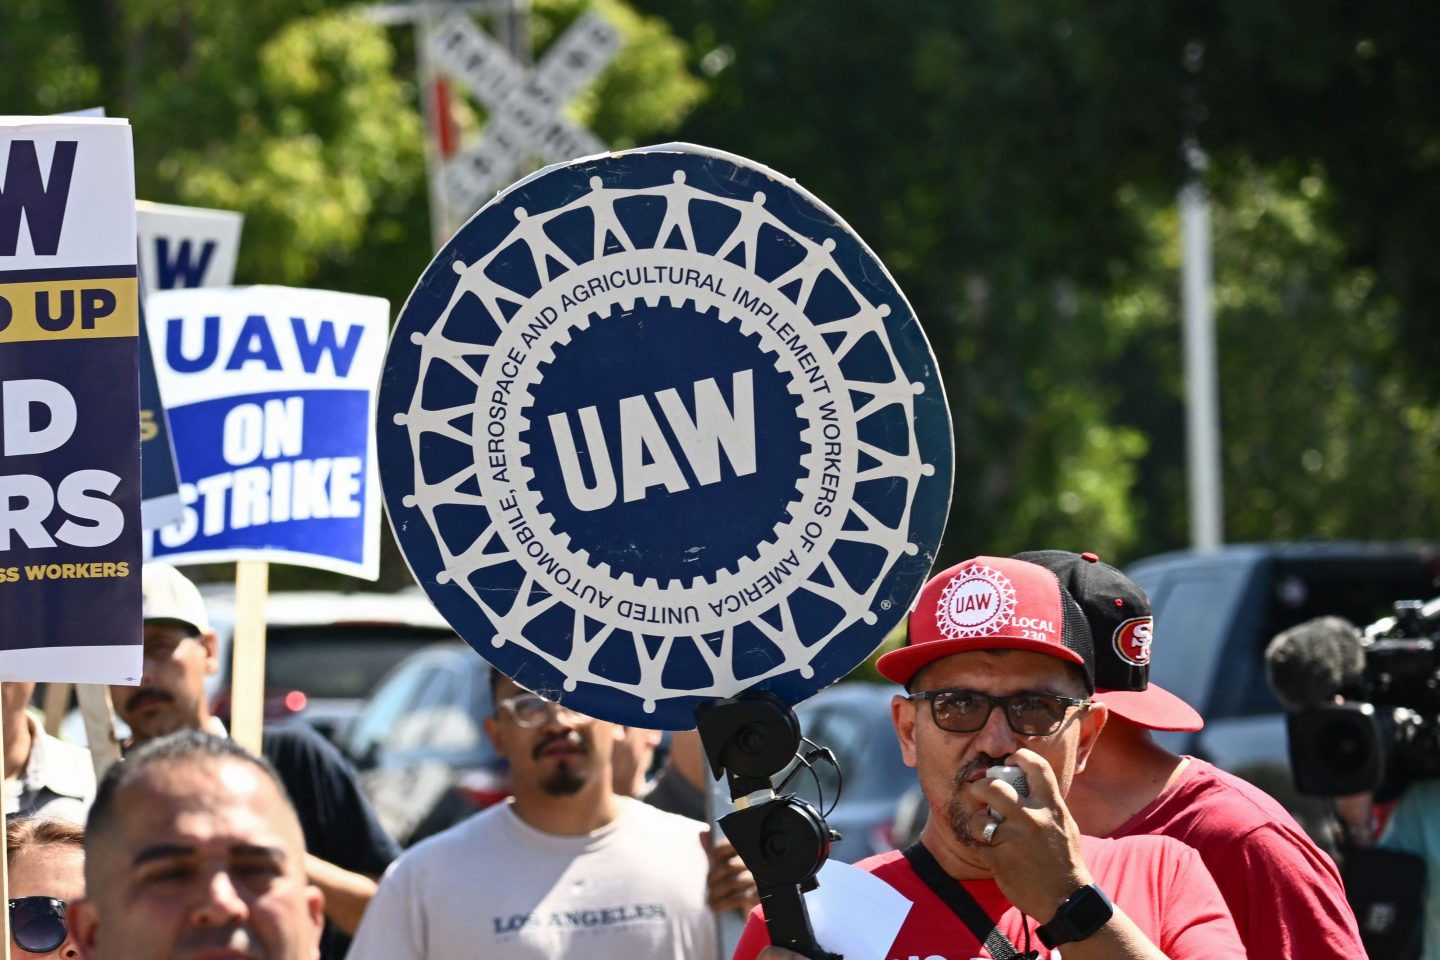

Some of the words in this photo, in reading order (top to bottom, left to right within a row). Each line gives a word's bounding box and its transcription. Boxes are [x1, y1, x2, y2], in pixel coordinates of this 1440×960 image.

[35, 288, 116, 334] UP
[560, 266, 727, 312] AGRICULTURAL
[165, 315, 365, 378] UAW
[520, 306, 559, 349] AND
[732, 286, 831, 394] IMPLEMENT
[223, 397, 304, 467] ON
[487, 347, 527, 482] AEROSPACE
[547, 369, 757, 511] UAW
[814, 400, 842, 518] WORKERS
[159, 456, 363, 548] STRIKE
[499, 489, 613, 609] AUTOMOBILE,
[799, 521, 823, 553] OF
[24, 561, 130, 582] WORKERS
[708, 549, 801, 618] AMERICA
[617, 600, 700, 624] UNITED
[955, 592, 992, 614] UAW
[1011, 616, 1056, 634] LOCAL
[1021, 629, 1047, 641] 230
[549, 904, 667, 927] ANGELES
